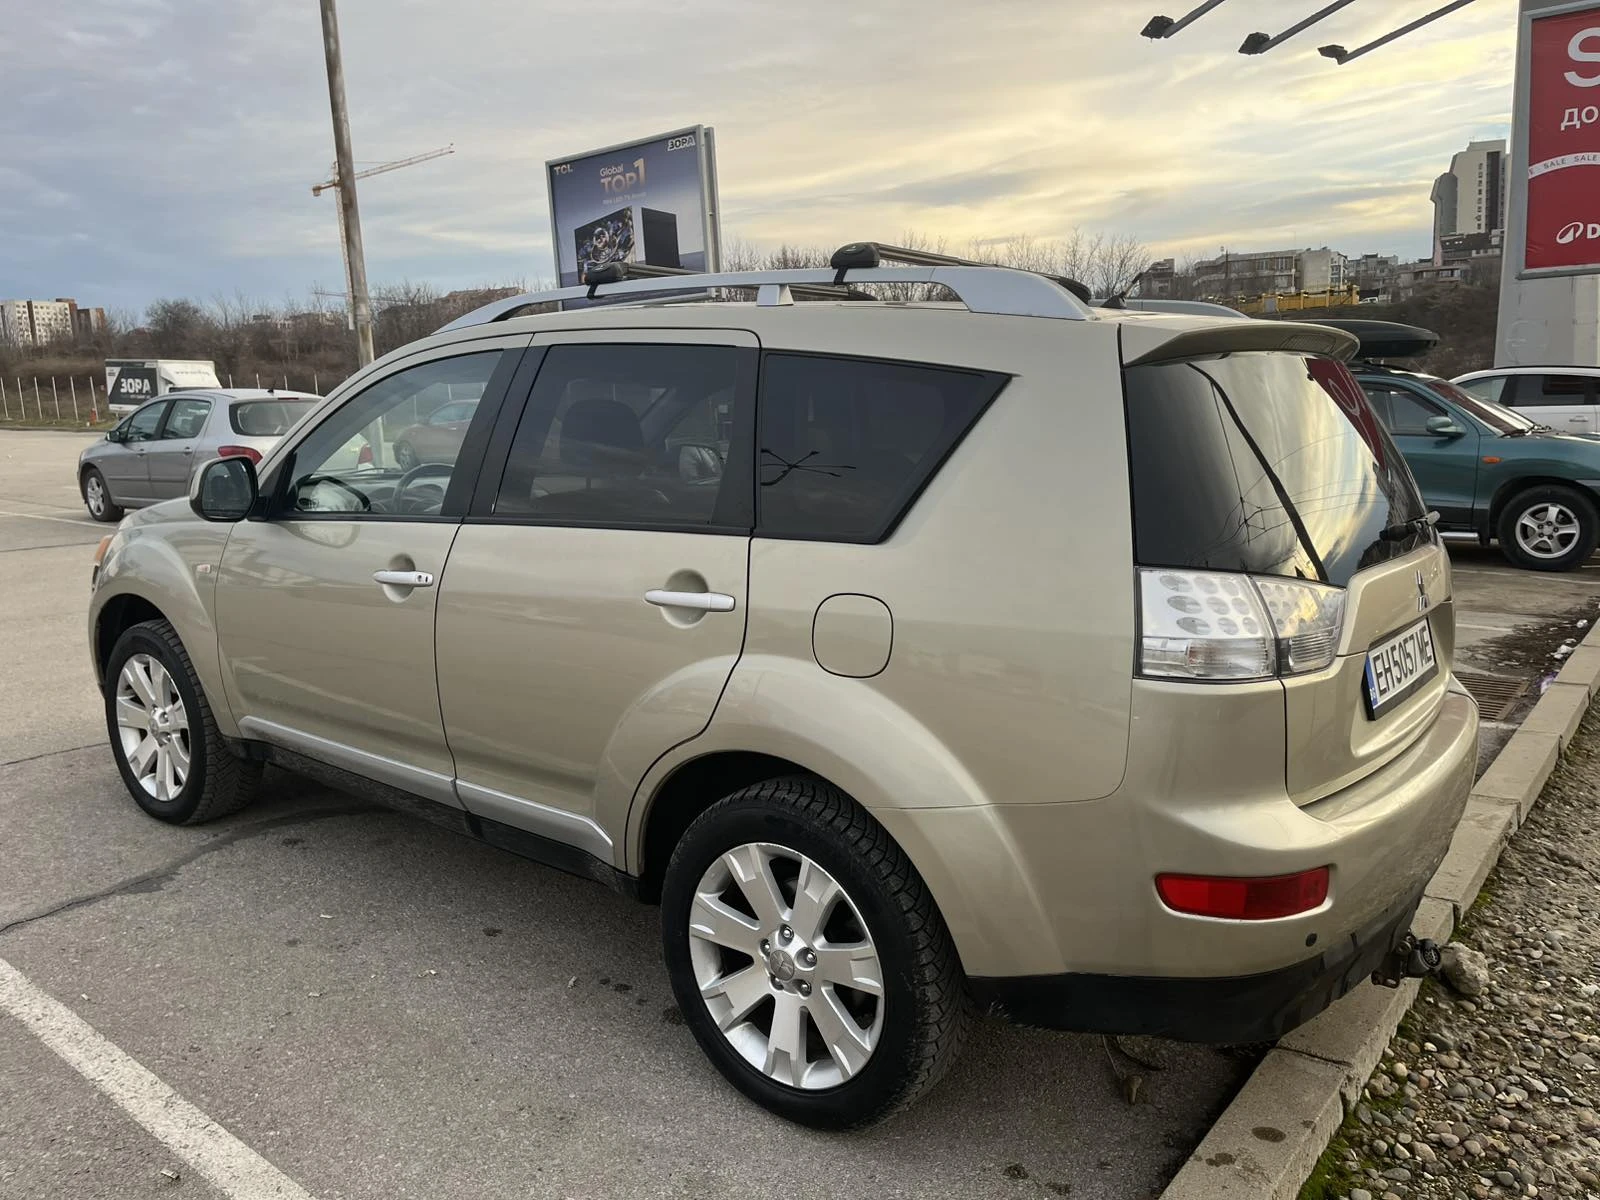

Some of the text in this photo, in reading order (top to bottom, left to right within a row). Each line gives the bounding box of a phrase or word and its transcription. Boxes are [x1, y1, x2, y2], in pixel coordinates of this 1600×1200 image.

[554, 164, 573, 175] TCL
[1544, 158, 1566, 169] SALE
[600, 163, 624, 177] Global
[120, 378, 152, 394] ЗОРА
